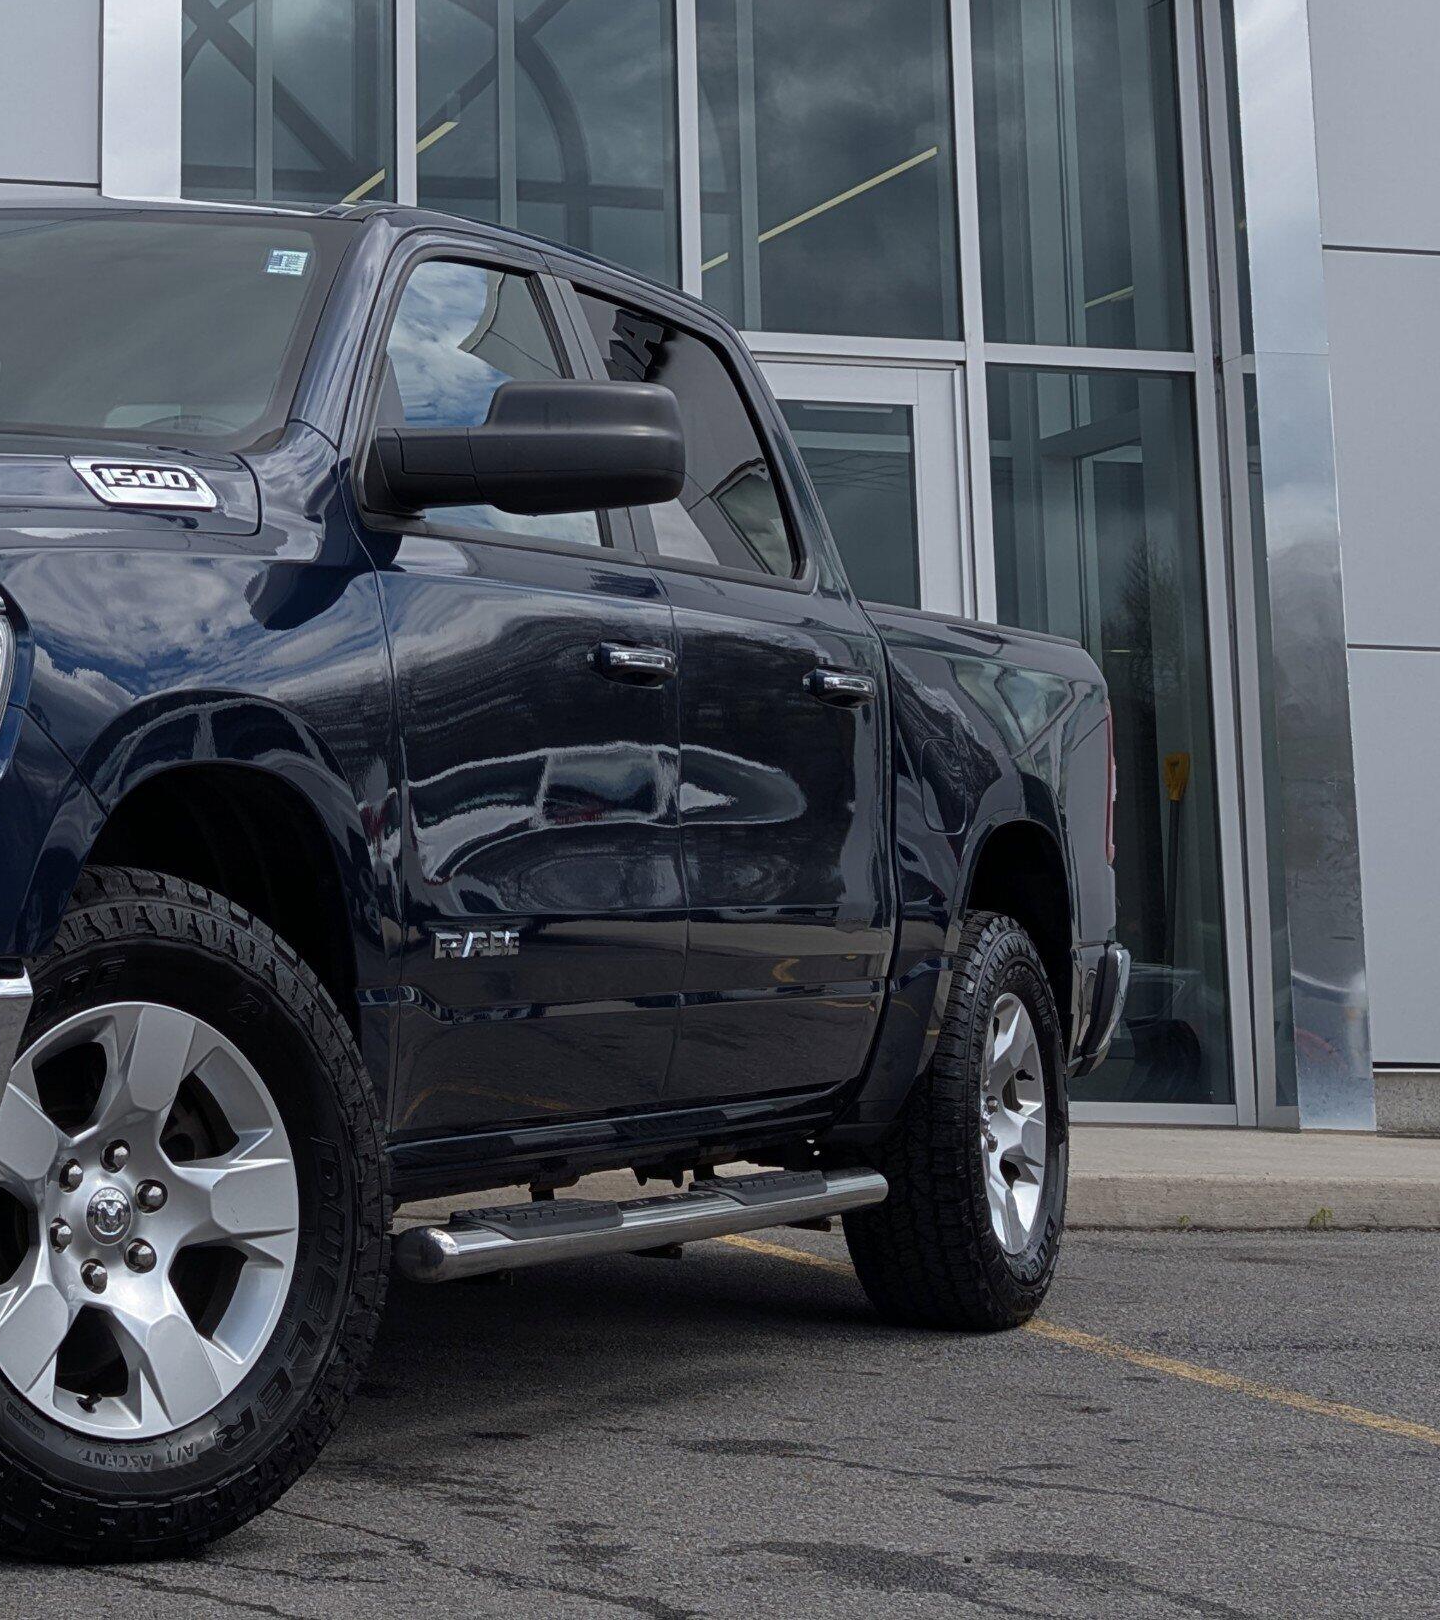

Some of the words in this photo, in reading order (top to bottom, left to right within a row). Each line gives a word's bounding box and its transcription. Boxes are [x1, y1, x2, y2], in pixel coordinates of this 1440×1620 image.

[96, 467, 190, 489] 1500
[434, 931, 520, 959] RAM
[213, 1136, 347, 1454] DUELER
[163, 1442, 196, 1467] A/T
